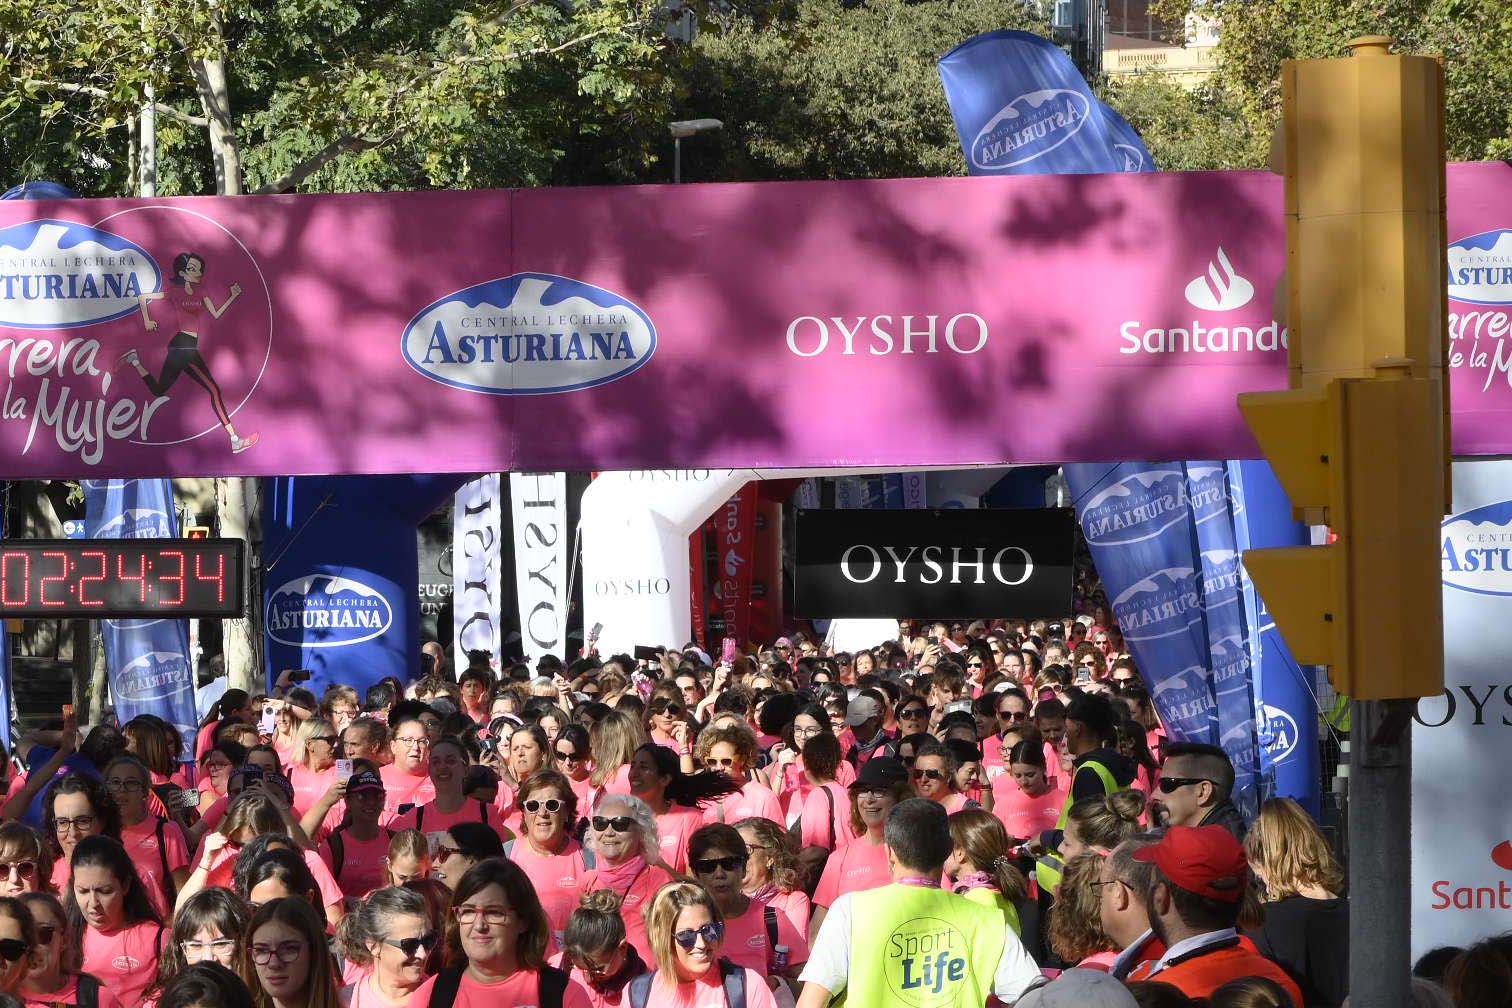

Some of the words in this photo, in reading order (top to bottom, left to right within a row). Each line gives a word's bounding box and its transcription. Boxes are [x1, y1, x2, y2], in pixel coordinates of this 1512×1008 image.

[64, 255, 137, 267] LECHERA
[461, 315, 540, 328] CENTRAL
[547, 314, 629, 327] LECHERA
[786, 313, 988, 357] OYSHO
[1448, 310, 1512, 340] arre
[422, 319, 637, 364] ASTURIANA
[1470, 340, 1488, 368] la
[2, 380, 27, 419] la
[21, 371, 171, 466] Mujer
[1, 551, 224, 606] 02:24:34
[840, 544, 1035, 586] OYSHO
[595, 577, 671, 595] OYSHO
[270, 604, 383, 631] ASTURIANA
[329, 598, 378, 608] LECHERA
[890, 926, 955, 960] Sport
[901, 951, 966, 994] Life
